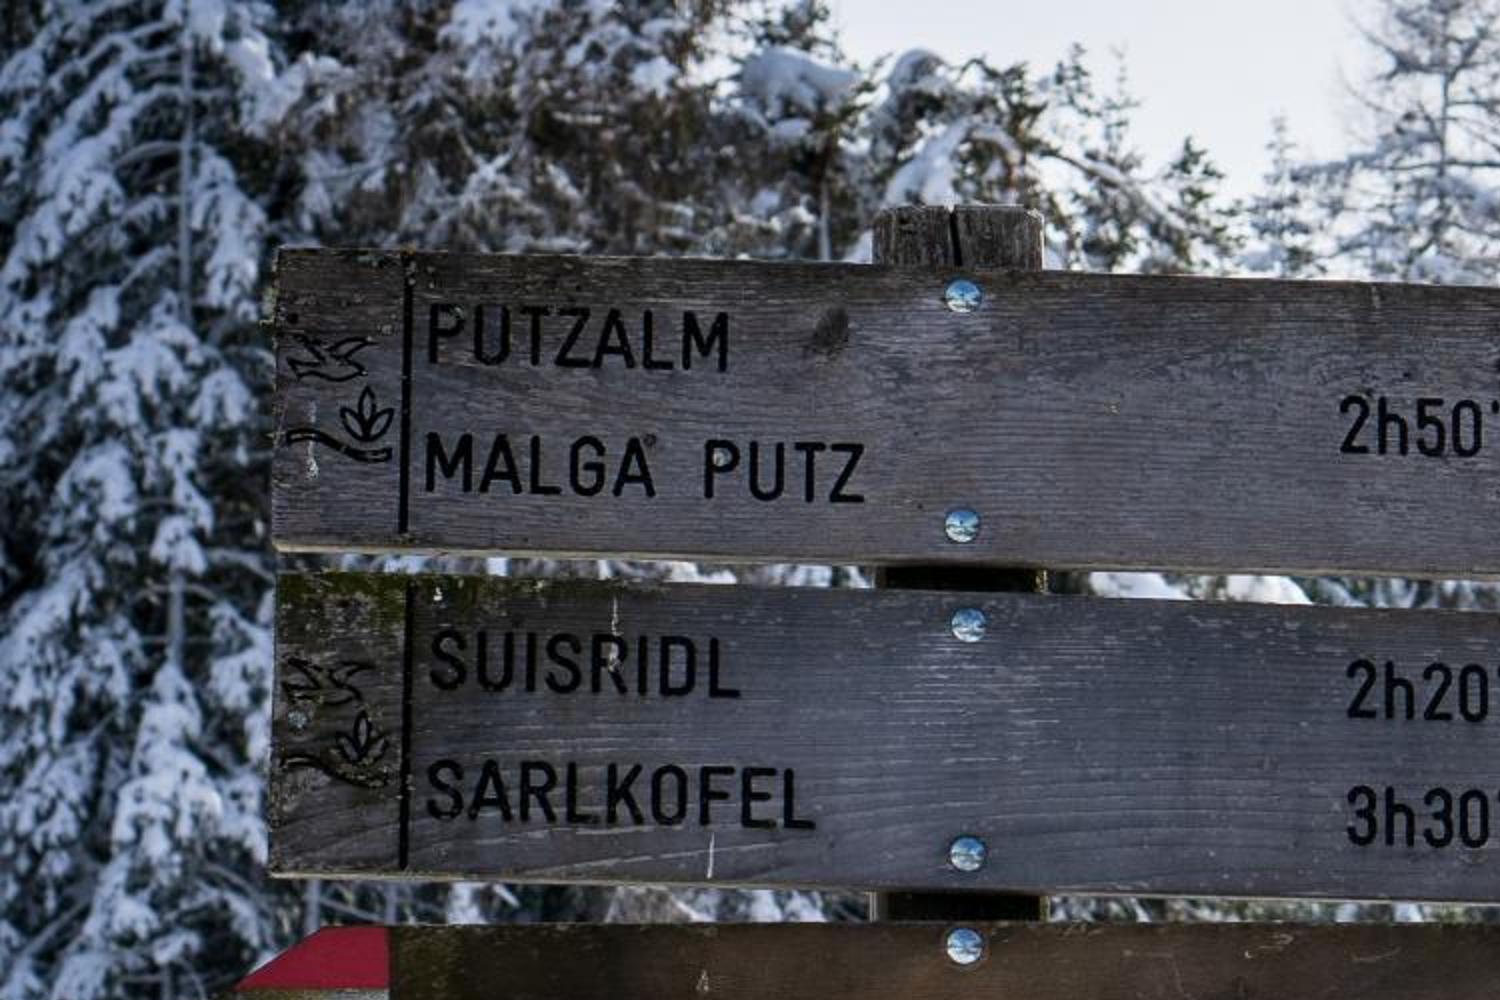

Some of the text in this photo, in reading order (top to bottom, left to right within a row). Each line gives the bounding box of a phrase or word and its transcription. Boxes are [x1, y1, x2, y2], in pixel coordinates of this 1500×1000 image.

[427, 303, 729, 372] PUTZALM
[425, 432, 865, 503] MALGA PUTZ
[428, 629, 741, 700] SUISRIDL
[426, 759, 817, 831] SARLKOFEL
